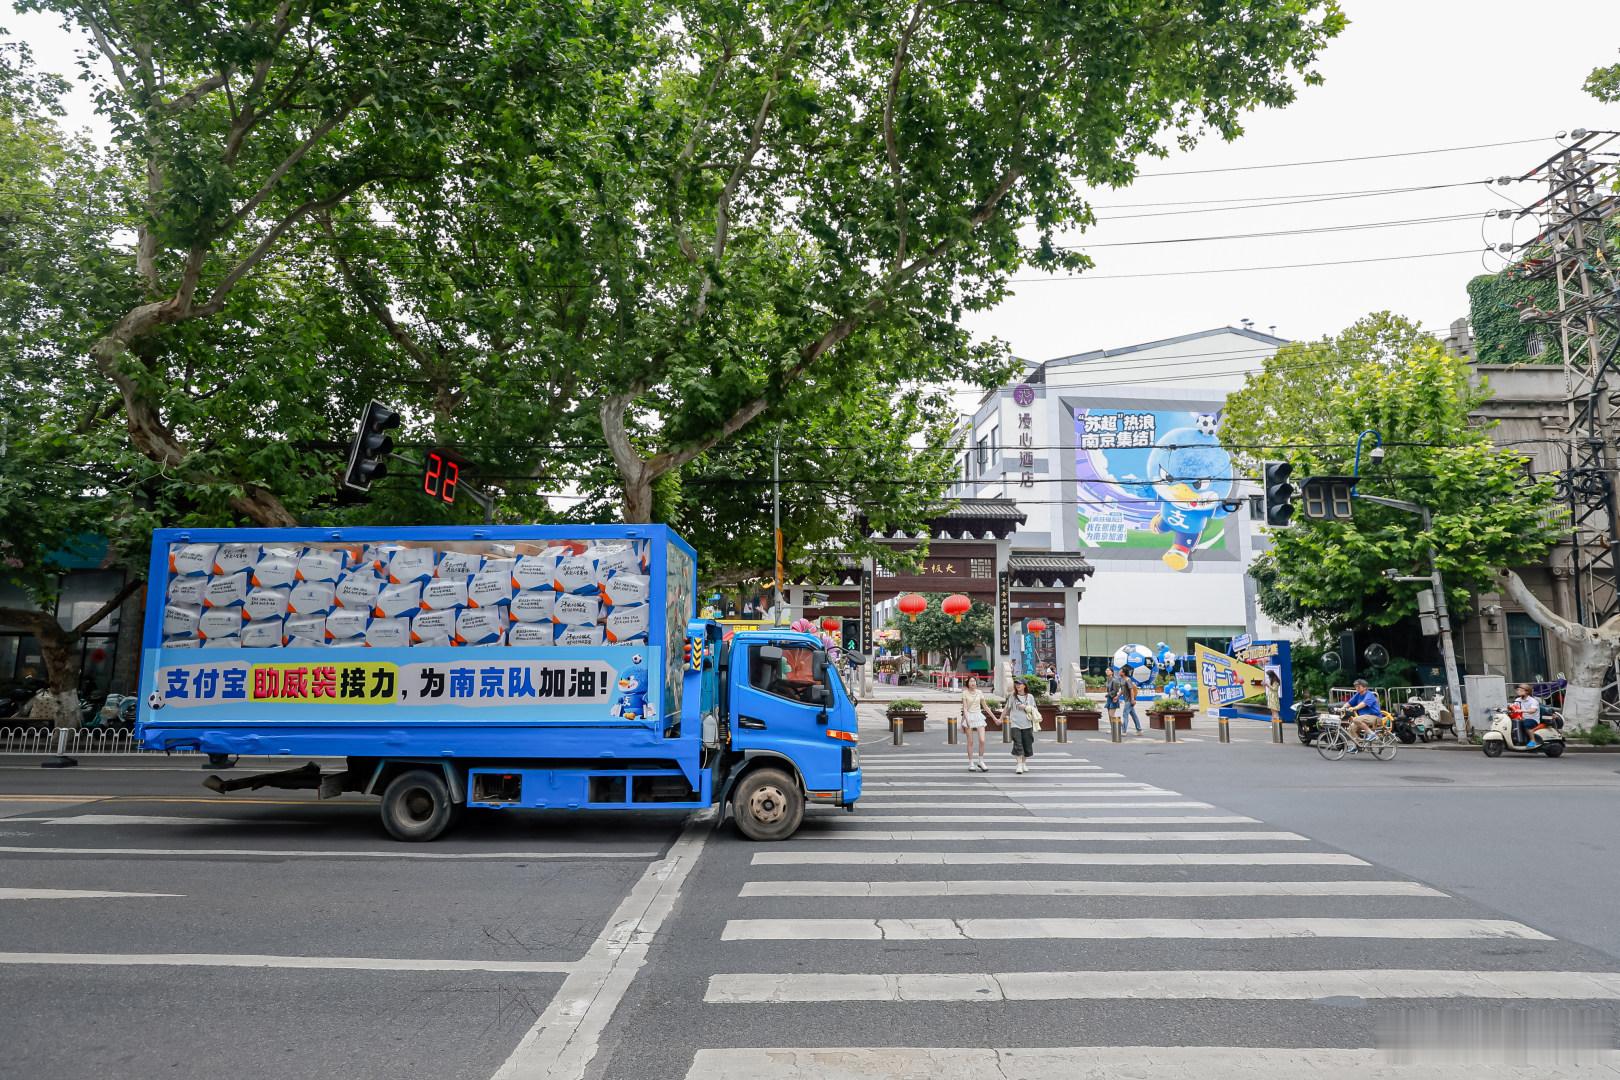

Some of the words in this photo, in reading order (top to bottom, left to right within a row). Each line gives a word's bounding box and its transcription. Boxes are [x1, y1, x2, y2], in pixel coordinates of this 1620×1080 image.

[1078, 412, 1155, 432] “苏超”热浪
[1018, 412, 1034, 488] 漫心酒店
[424, 452, 459, 503] 22
[164, 667, 608, 700] 支付宝助威袋接力，为南京队加油！
